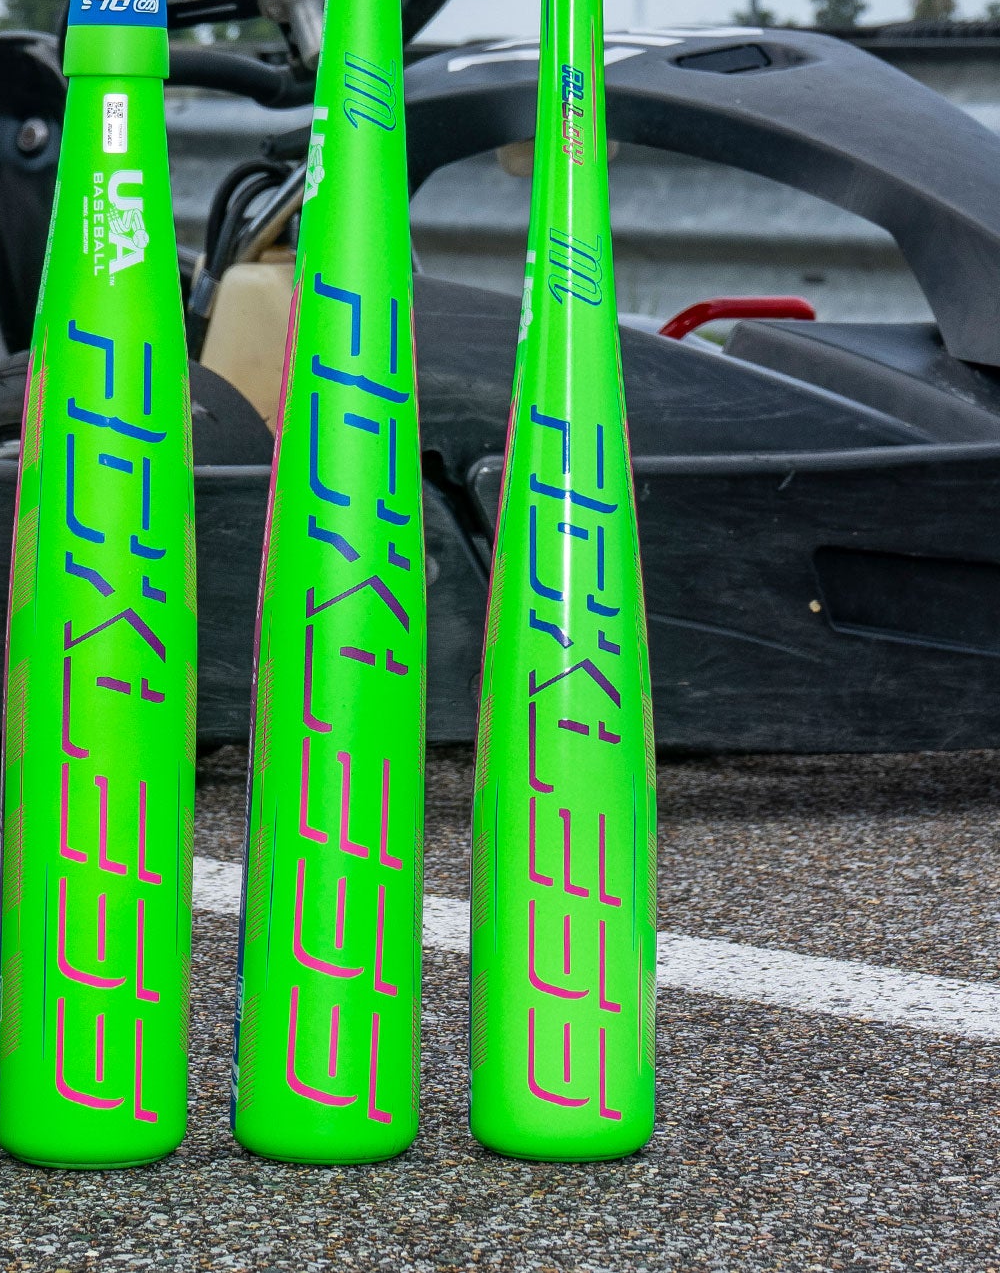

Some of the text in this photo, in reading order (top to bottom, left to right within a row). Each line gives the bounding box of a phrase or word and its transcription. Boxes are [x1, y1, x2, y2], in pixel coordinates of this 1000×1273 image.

[561, 63, 585, 165] ALLOY
[93, 171, 104, 276] BASEBALL
[107, 168, 150, 276] USA
